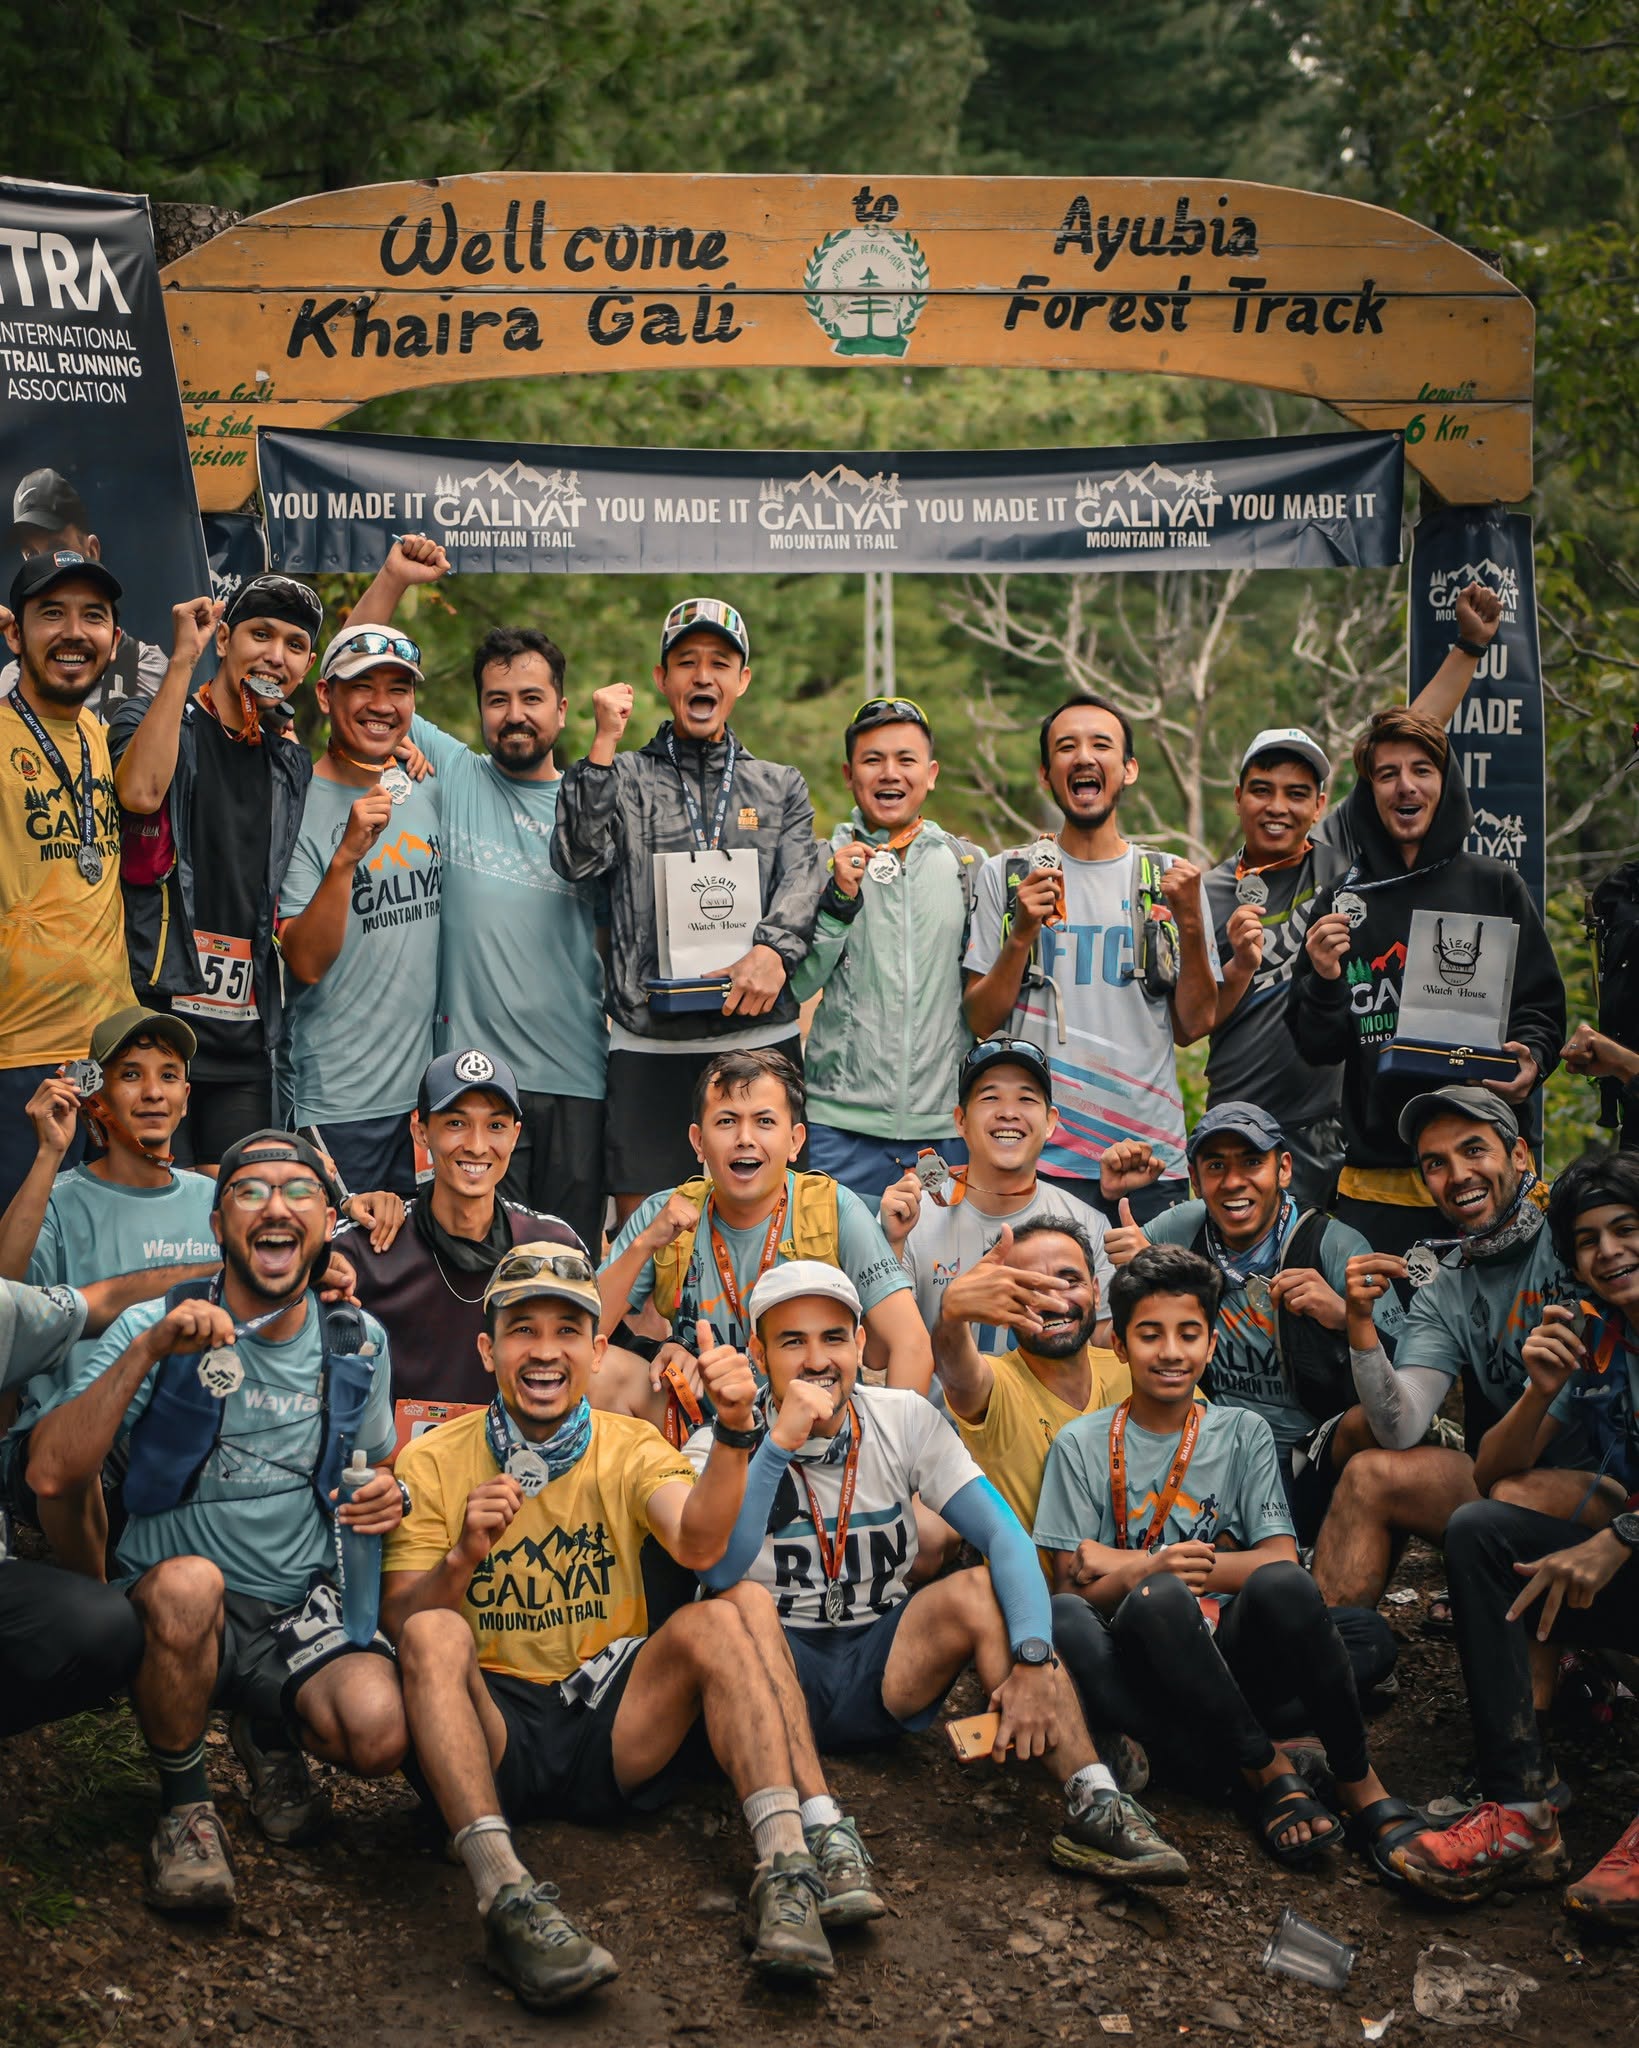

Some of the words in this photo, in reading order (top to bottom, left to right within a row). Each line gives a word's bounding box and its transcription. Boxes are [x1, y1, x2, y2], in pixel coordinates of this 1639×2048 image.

[852, 186, 899, 223] to
[1053, 195, 1259, 273] Ayubia
[287, 294, 543, 358] Khaira
[588, 282, 743, 346] Gali
[1003, 275, 1192, 333] Forest
[1229, 276, 1388, 335] Track
[0, 350, 56, 373] TRAIL
[58, 352, 142, 378] RUNNING
[8, 377, 127, 404] ASSOCIATION
[216, 415, 254, 436] Sub
[1405, 413, 1426, 445] 6
[1434, 414, 1470, 442] Km
[269, 492, 319, 520] YOU
[328, 493, 396, 520] MADE
[405, 493, 426, 520] IT
[433, 497, 587, 528] GALIYAT
[596, 497, 645, 523] YOU
[654, 498, 721, 523] MADE
[729, 498, 750, 523] IT
[758, 500, 908, 530] GALIYAT
[916, 498, 975, 523] YOU
[978, 498, 1039, 523] MADE
[1046, 497, 1068, 522] IT
[1075, 495, 1223, 528] GALIYAT
[1229, 493, 1275, 521] YOU
[1283, 493, 1347, 520] MADE
[1355, 493, 1376, 519] IT
[444, 531, 529, 548] MOUNTAIN
[531, 531, 576, 548] TRAIL
[770, 534, 850, 550] MOUNTAIN
[854, 534, 898, 550] TRAIL
[1086, 531, 1166, 549] MOUNTAIN
[1169, 531, 1211, 548] TRAIL
[1464, 752, 1492, 789] IT
[691, 875, 738, 893] Nizam
[363, 903, 423, 934] MOUNTAIN
[688, 921, 716, 932] Watch
[720, 920, 747, 931] House
[1041, 925, 1133, 988] FTC
[1423, 984, 1453, 996] Watch
[1457, 987, 1487, 999] House
[1180, 1429, 1195, 1462] GALIYAT
[774, 1519, 908, 1590] RUN
[479, 1607, 564, 1632] MOUNTAIN
[566, 1600, 608, 1625] TRAIL
